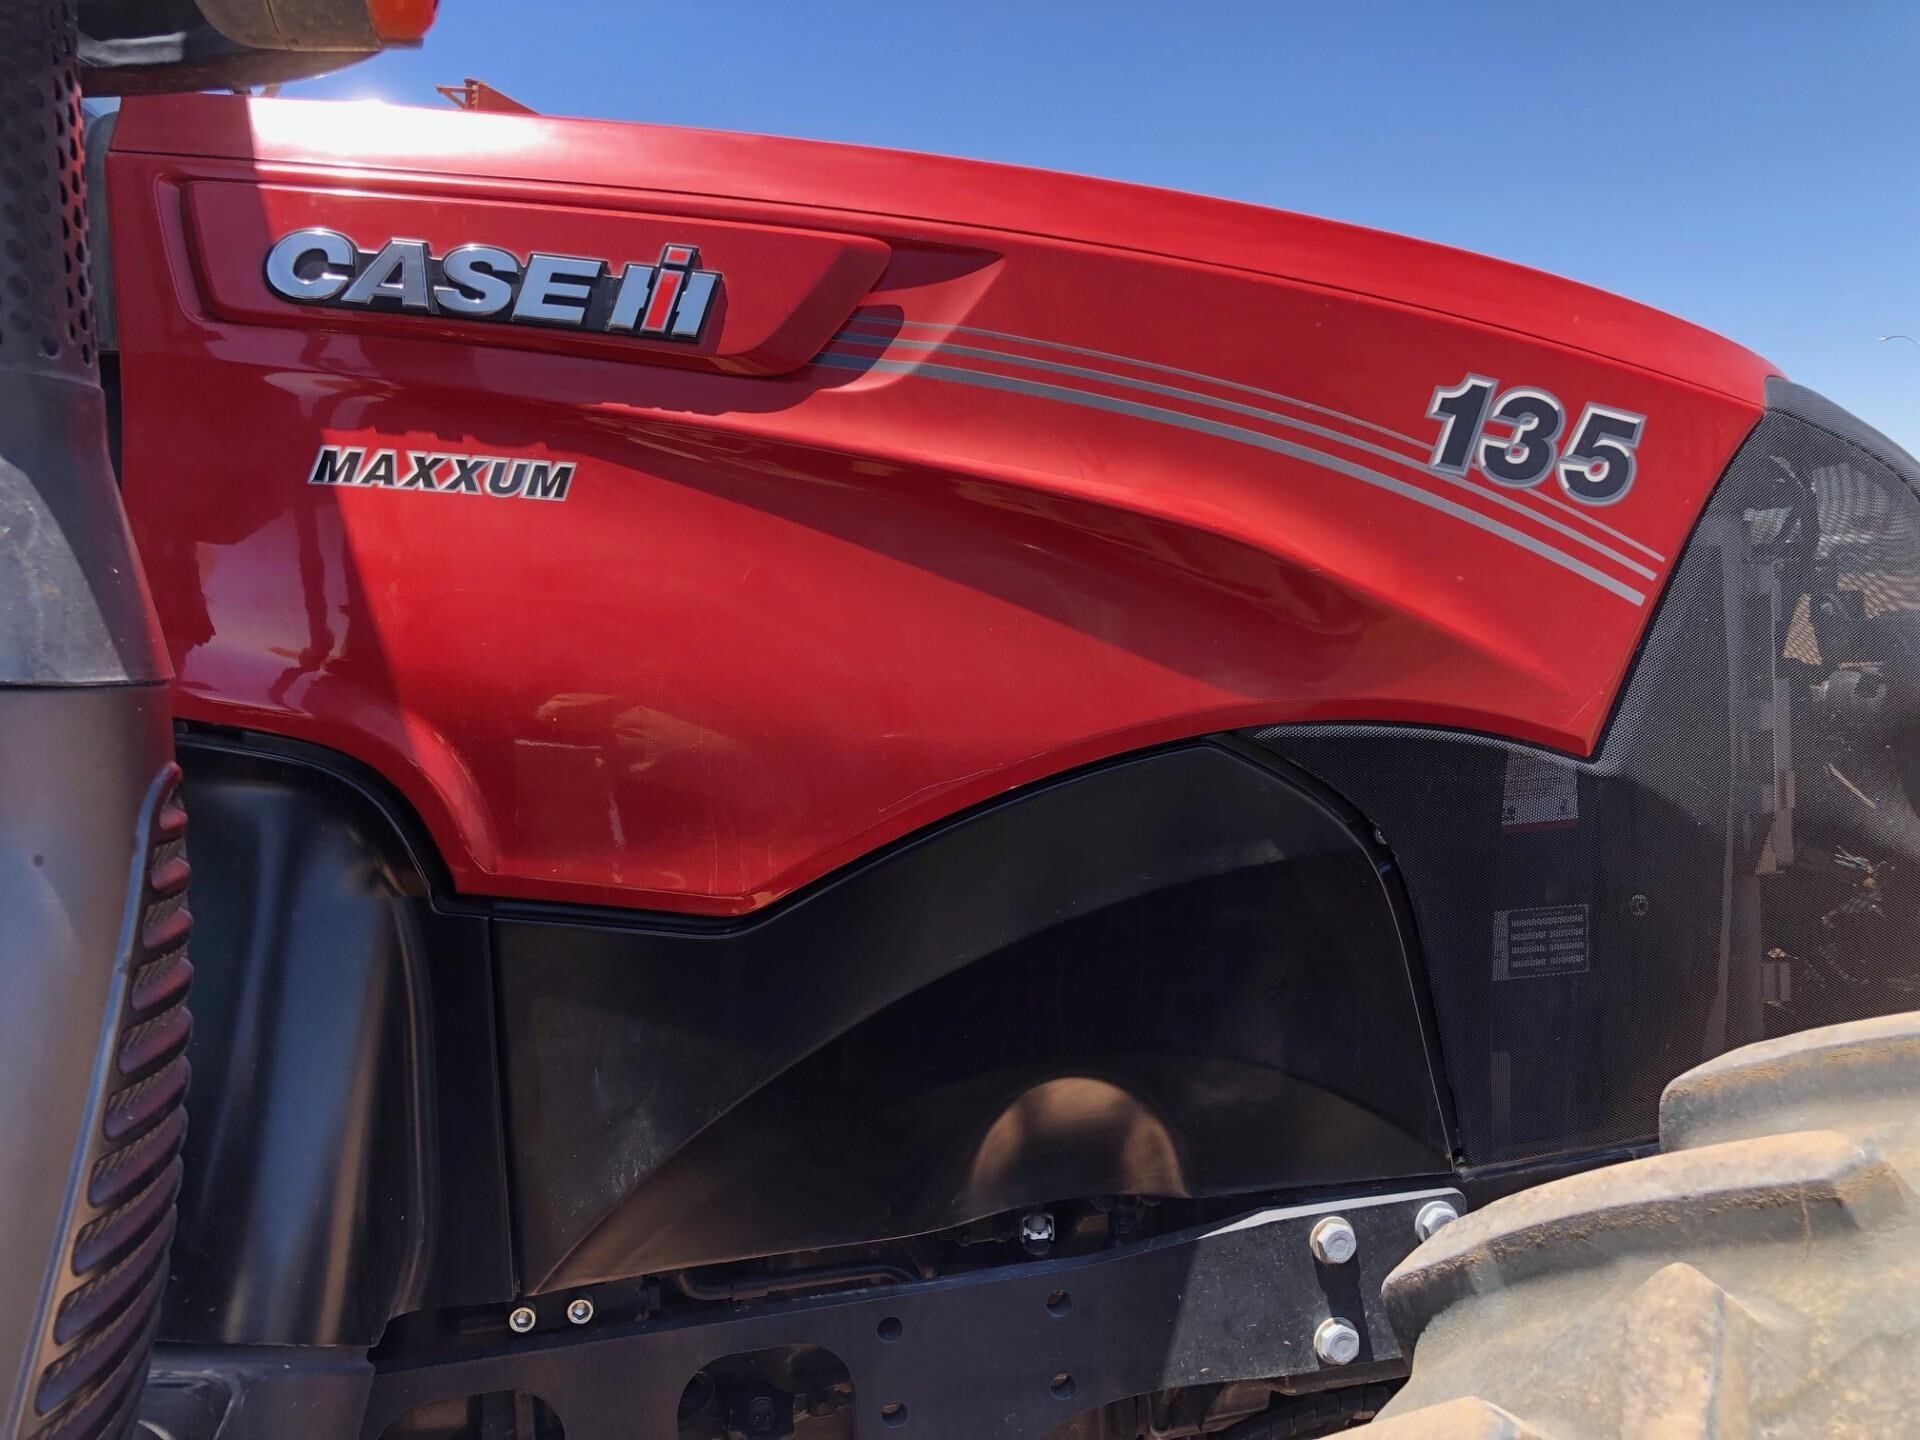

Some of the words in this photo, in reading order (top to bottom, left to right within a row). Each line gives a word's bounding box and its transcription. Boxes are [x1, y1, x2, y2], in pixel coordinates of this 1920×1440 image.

[264, 228, 606, 325] CASE
[308, 445, 577, 501] MAXXUM
[1426, 373, 1647, 506] 135
